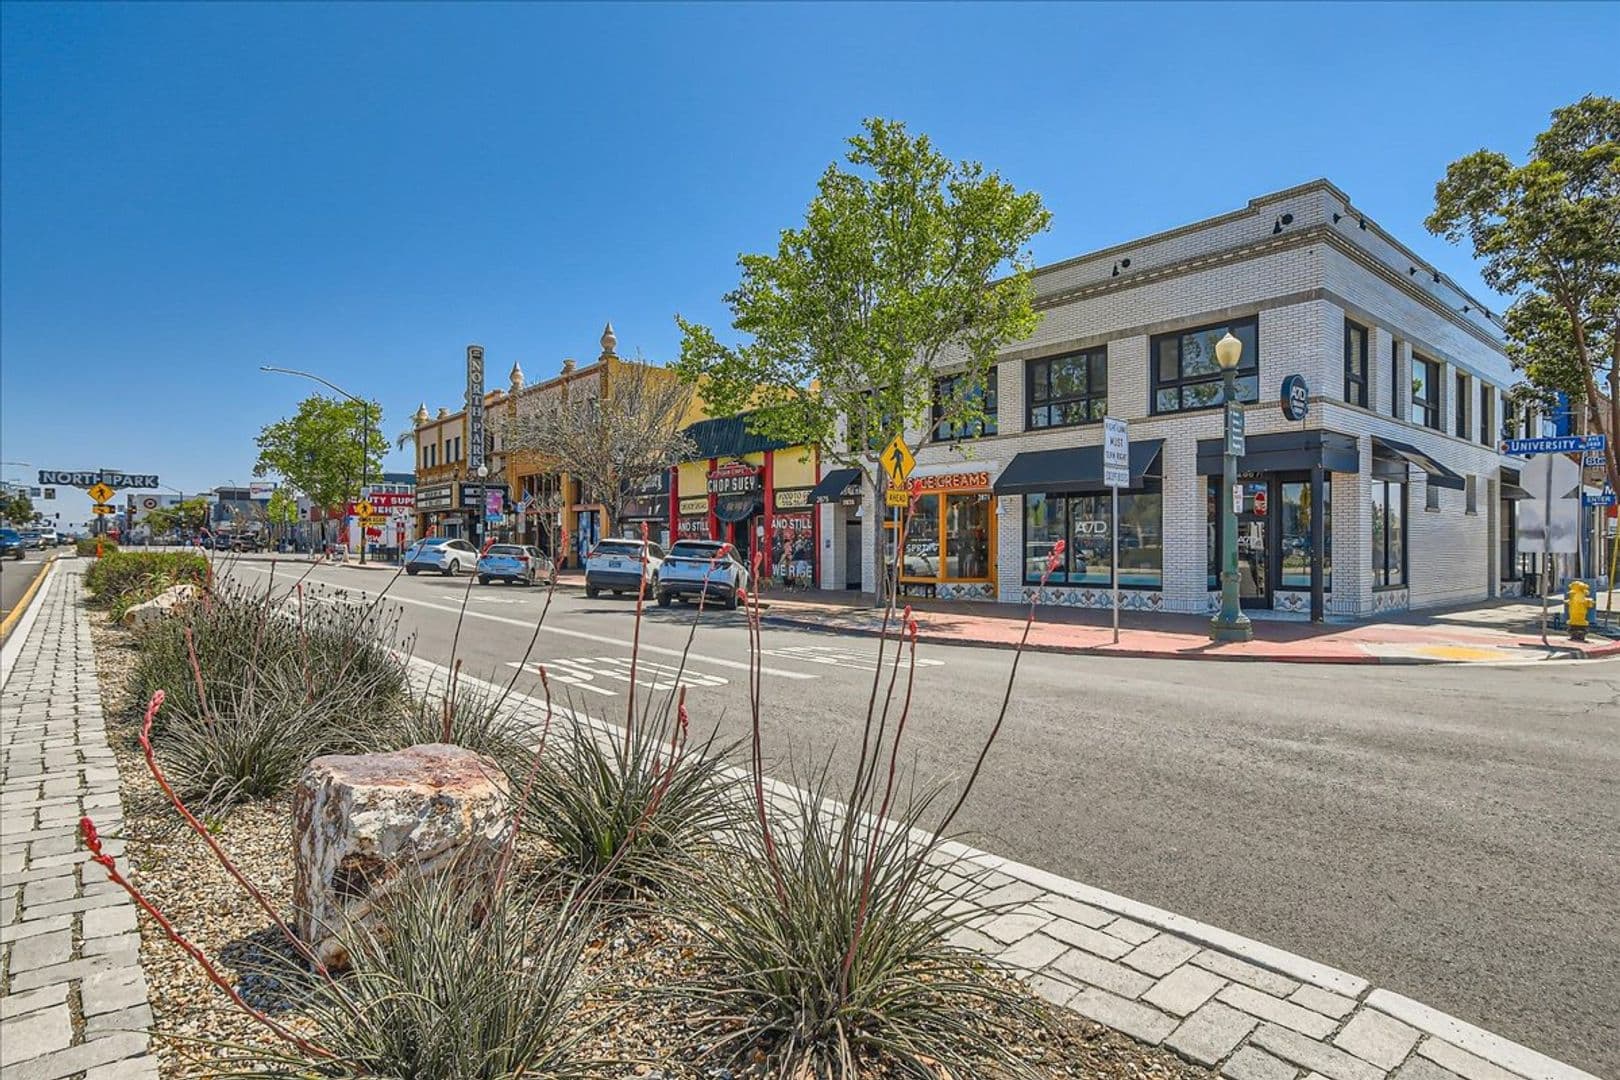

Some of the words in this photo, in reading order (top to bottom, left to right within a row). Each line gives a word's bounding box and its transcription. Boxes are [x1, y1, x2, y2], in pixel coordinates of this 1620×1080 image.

[471, 360, 482, 417] NORTH
[471, 422, 482, 466] PARK
[1511, 440, 1576, 451] UNIVERSITY
[43, 471, 102, 484] NORTH
[113, 475, 156, 487] PARK
[707, 479, 730, 493] CHOP
[731, 475, 755, 491] SUEY
[936, 472, 988, 489] CREAMS
[889, 494, 906, 502] AHEAD
[1586, 495, 1611, 503] ENTER
[678, 522, 691, 532] AND
[691, 520, 709, 531] STILL
[771, 518, 788, 529] AND
[789, 518, 812, 529] STILL
[771, 563, 786, 576] WE
[788, 565, 813, 578] RISE
